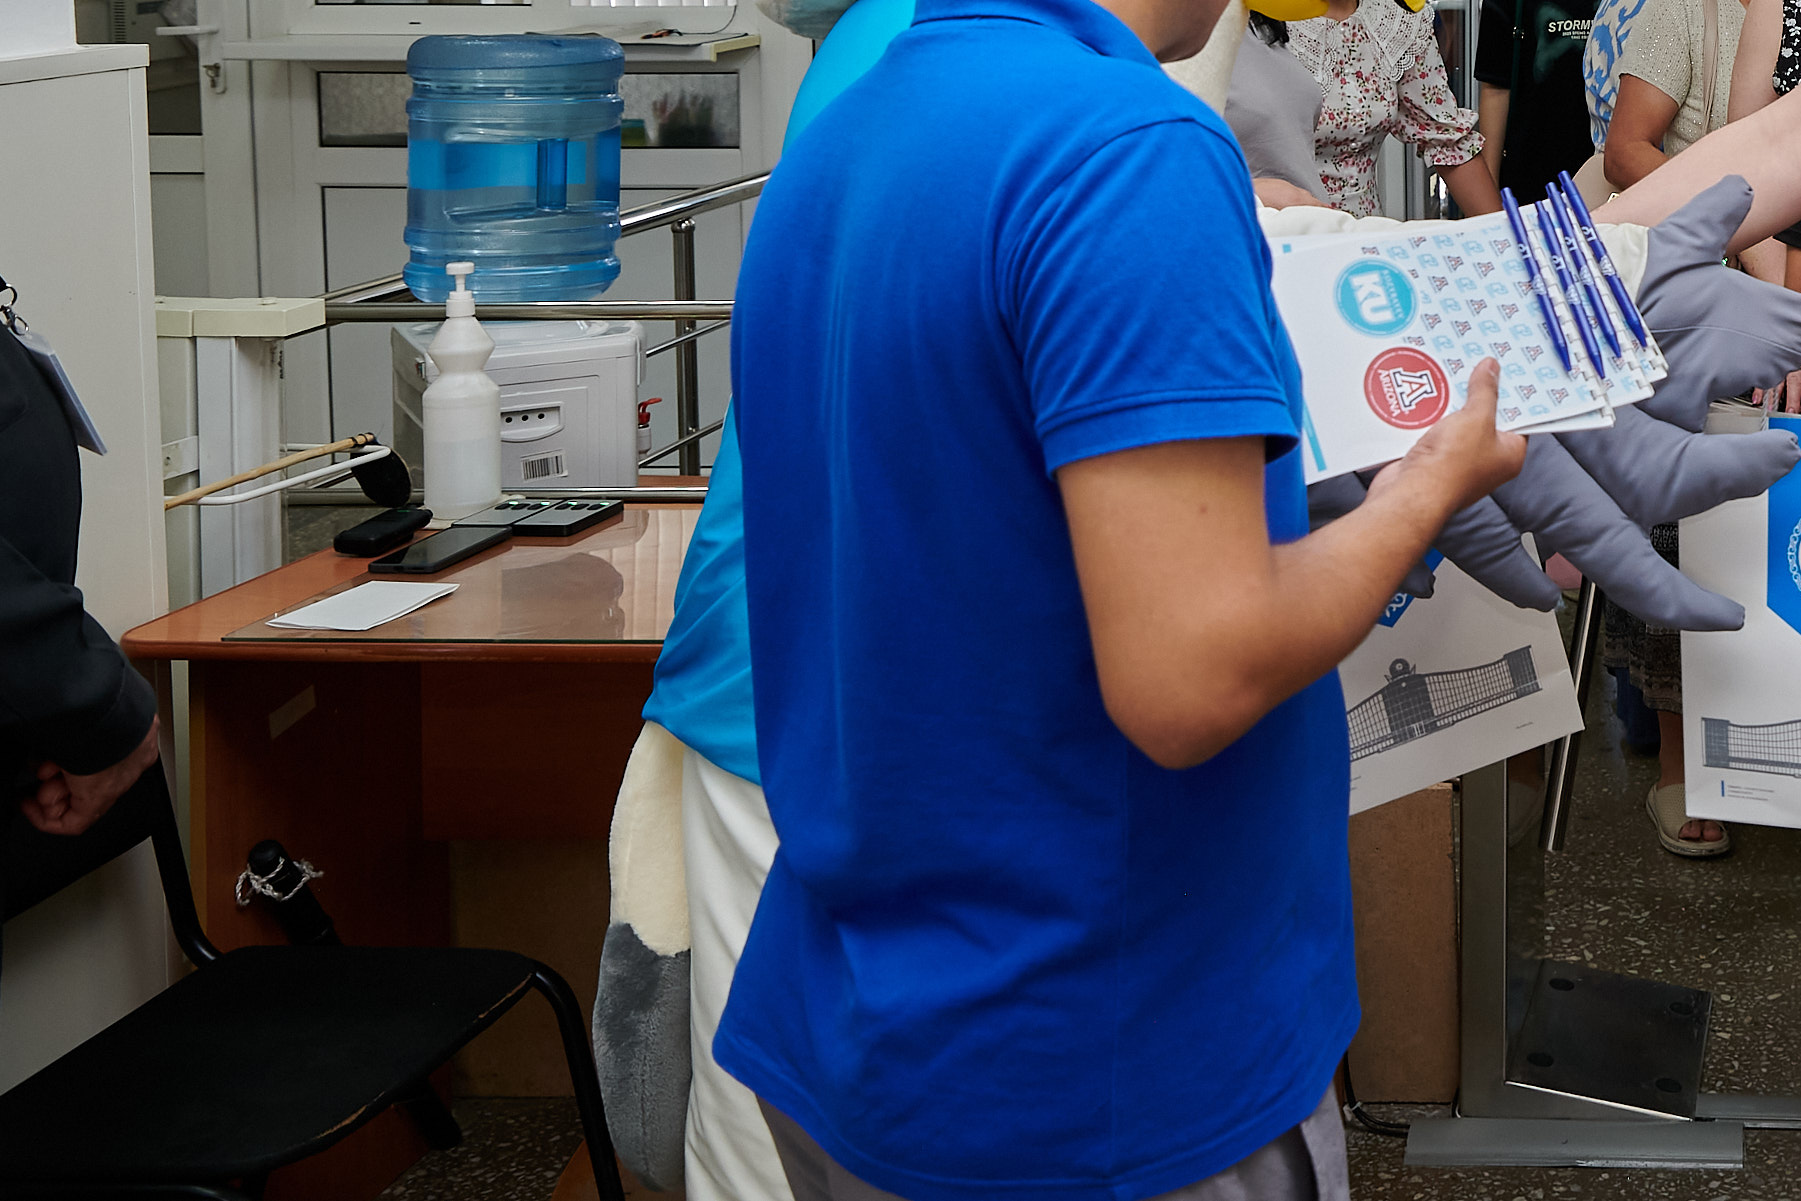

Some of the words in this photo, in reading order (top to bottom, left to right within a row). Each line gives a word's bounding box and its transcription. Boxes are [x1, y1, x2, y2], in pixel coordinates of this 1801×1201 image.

[1548, 19, 1594, 33] STORM
[1347, 270, 1397, 325] KU
[1377, 369, 1401, 417] ARIZONA
[1389, 367, 1438, 411] A
